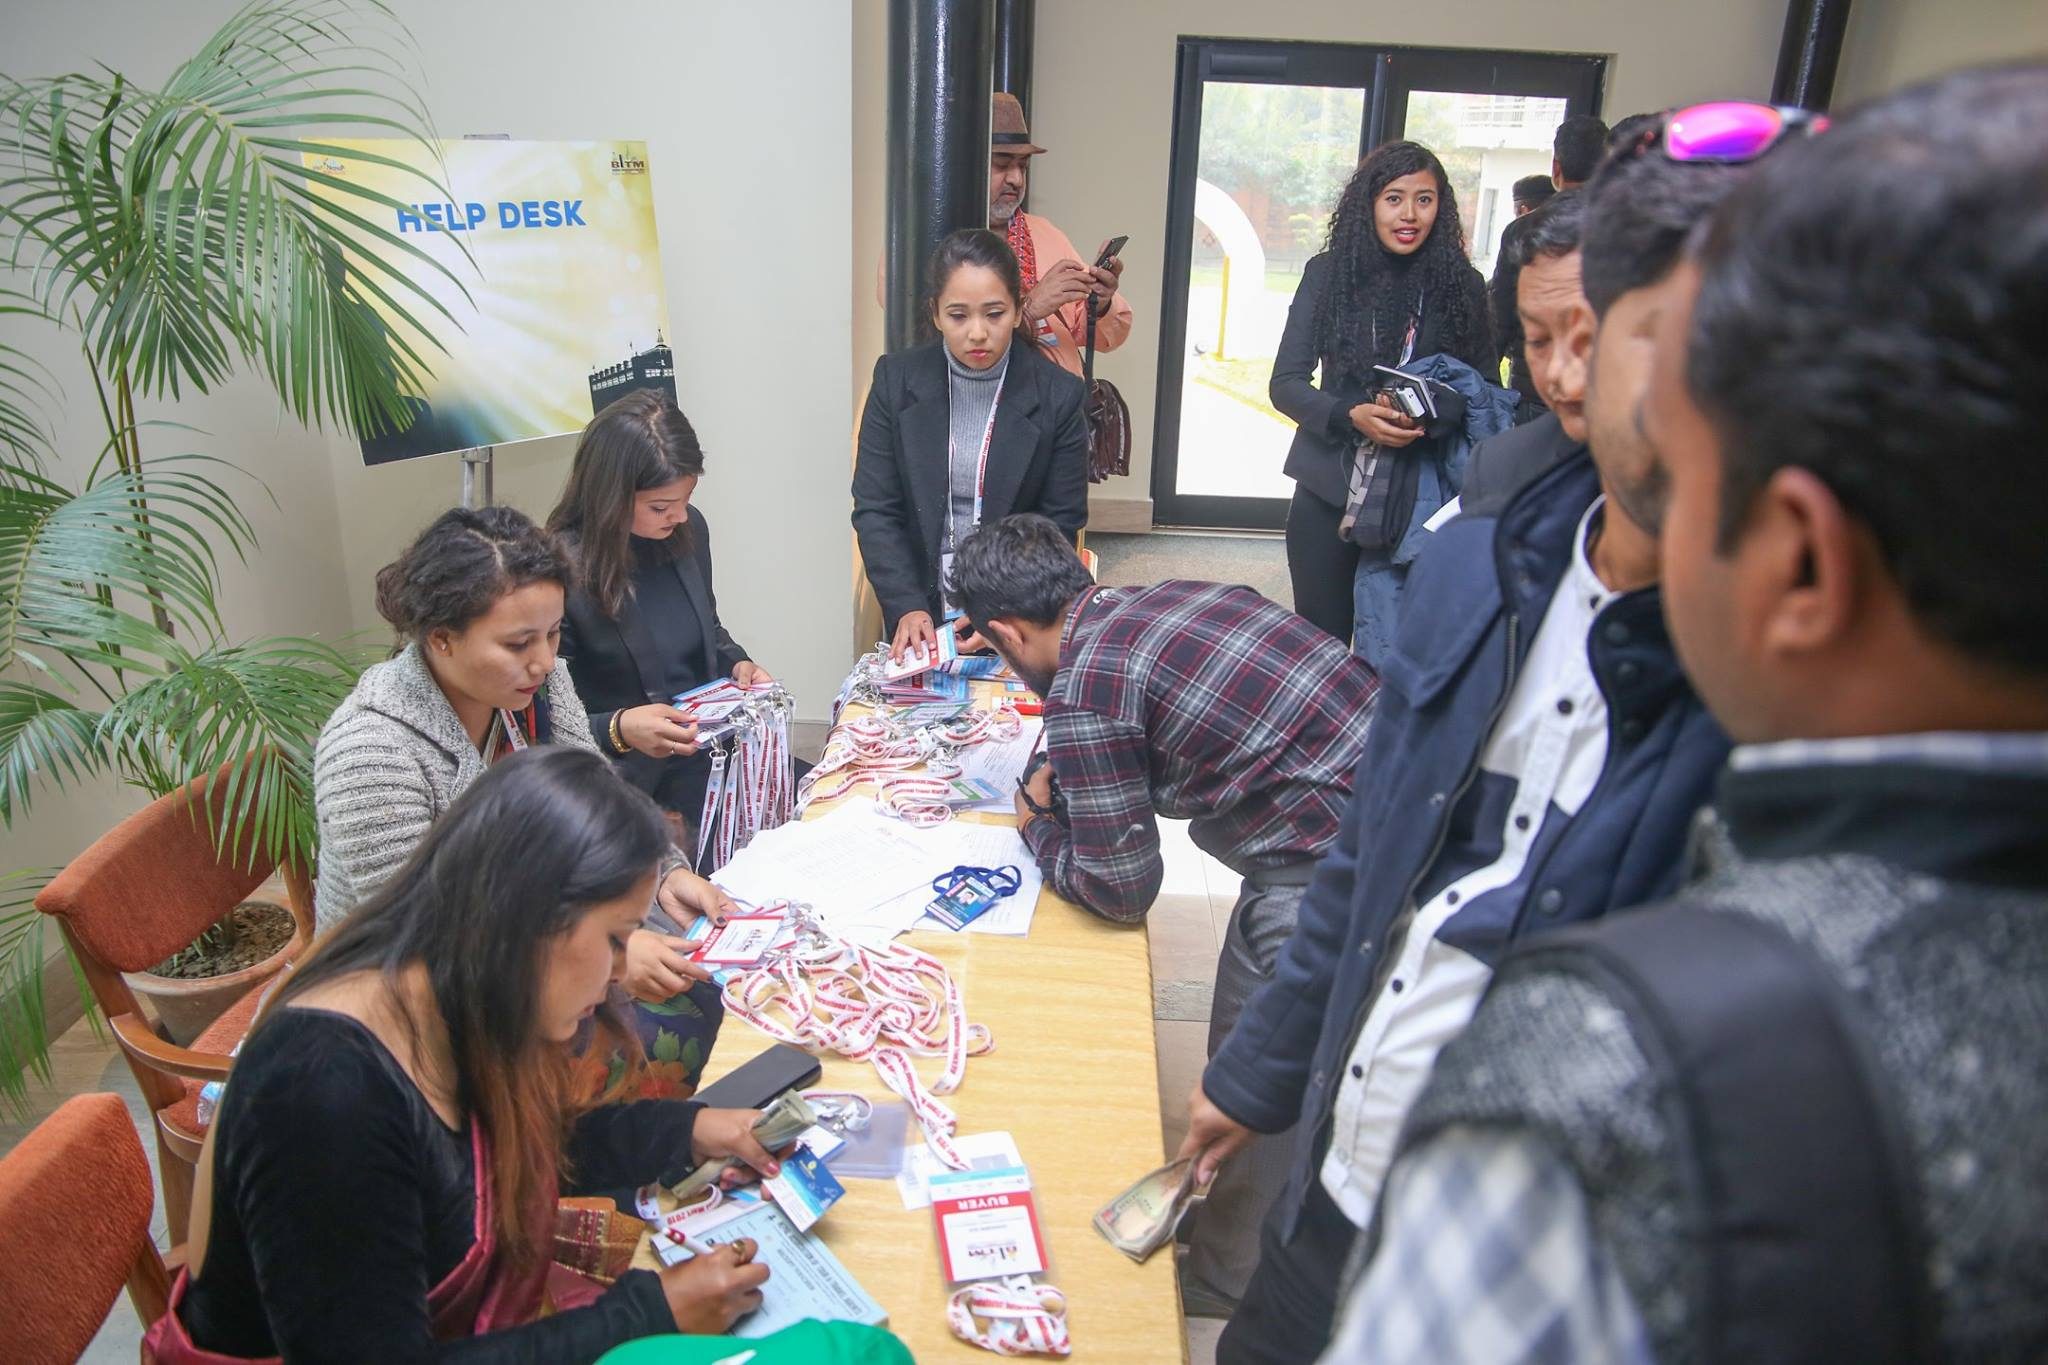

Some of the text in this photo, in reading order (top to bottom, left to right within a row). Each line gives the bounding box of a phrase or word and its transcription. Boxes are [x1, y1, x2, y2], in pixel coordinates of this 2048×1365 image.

[397, 200, 586, 233] HELP DESK
[957, 1194, 1009, 1210] BUYER
